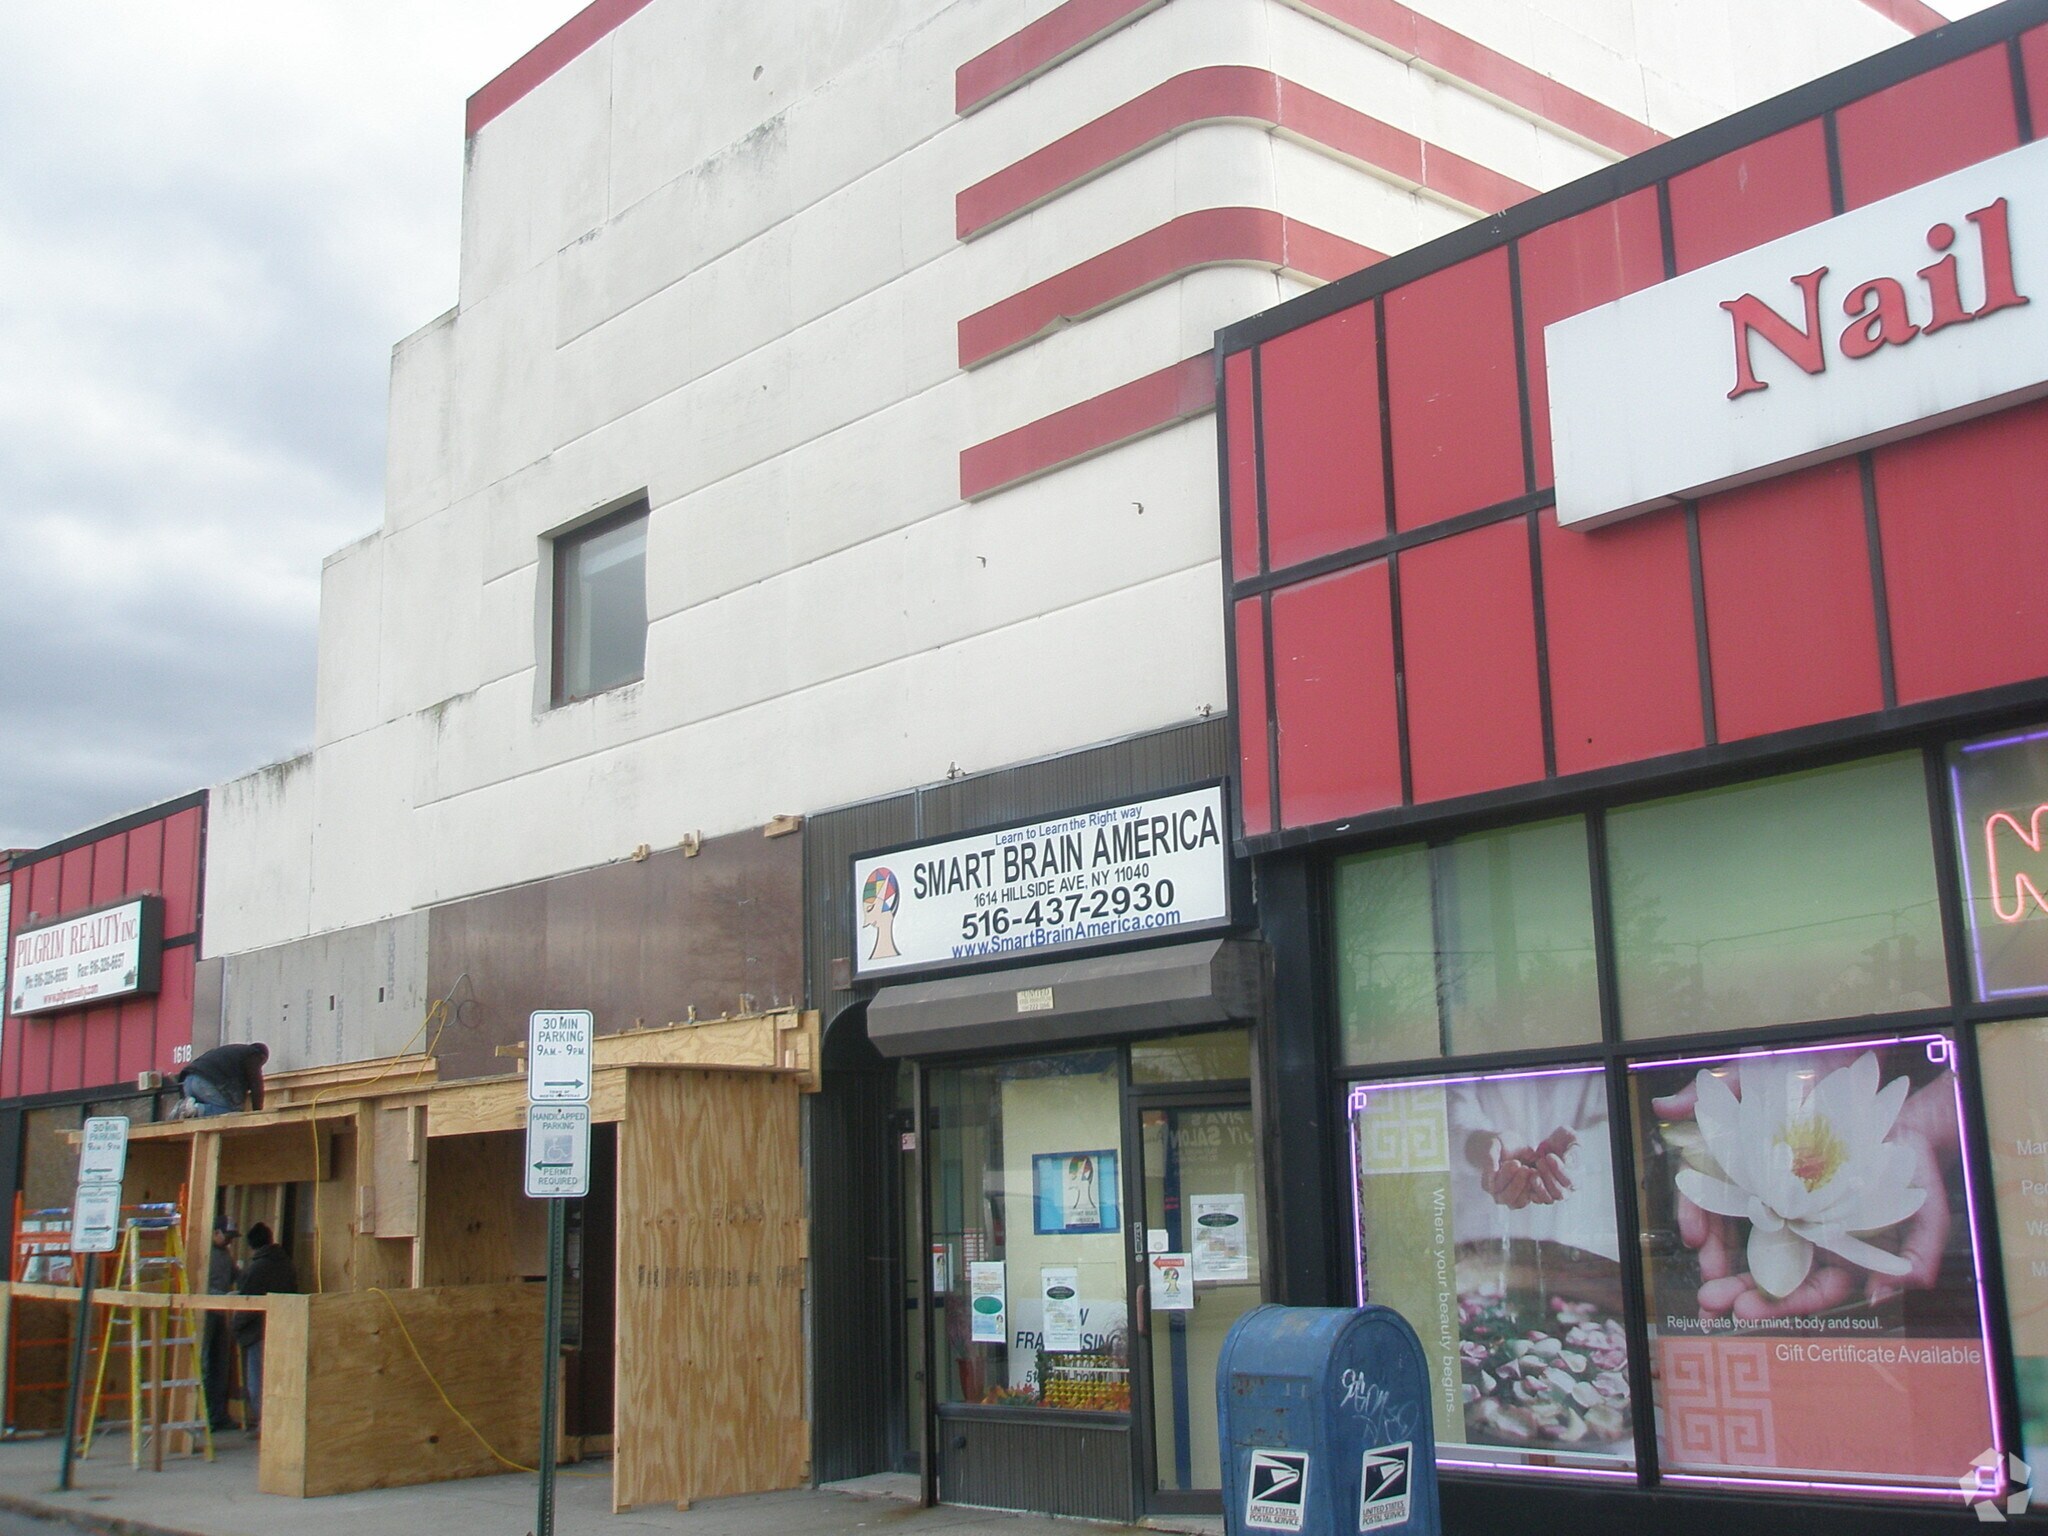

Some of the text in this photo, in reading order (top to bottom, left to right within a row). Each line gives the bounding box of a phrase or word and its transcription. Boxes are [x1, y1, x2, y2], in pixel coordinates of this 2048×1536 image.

[1719, 196, 2030, 401] Nail
[995, 805, 1143, 847] Learn to Learn the Right way
[913, 805, 1221, 900] SMART BRAIN AMERICA
[973, 891, 998, 908] 1614
[1001, 882, 1055, 903] HILLSIDE
[1092, 869, 1110, 887] NY
[1114, 862, 1150, 882] 11040
[962, 878, 1175, 940] 516-437-2930
[16, 928, 65, 968] PILGRIM
[70, 911, 123, 956] REALTY
[952, 908, 1181, 960] www.SmartBrainAmerica.com
[543, 1018, 578, 1030] 30 MIN
[539, 1031, 584, 1042] PARKING
[173, 1044, 192, 1064] 1618
[532, 1113, 586, 1121] HANDICAPPED
[542, 1122, 575, 1130] PARKING
[538, 1177, 578, 1185] REQUIRED
[543, 1168, 572, 1176] PERMIT
[1432, 1188, 1446, 1244] Where
[1434, 1249, 1447, 1287] your
[1436, 1293, 1450, 1348] beauty
[1667, 1315, 1731, 1331] Rejuvenate
[1733, 1318, 1760, 1331] your
[1795, 1316, 1825, 1331] body
[1827, 1316, 1850, 1329] and
[1852, 1316, 1883, 1330] soul.
[1775, 1343, 1981, 1365] Gift Certificate Available
[1250, 1505, 1297, 1517] UNITED STATES
[1362, 1509, 1406, 1525] POSTAL SERVICE
[1363, 1500, 1404, 1515] UNITED STATES
[1250, 1514, 1299, 1526] POSTAL SERVICE
